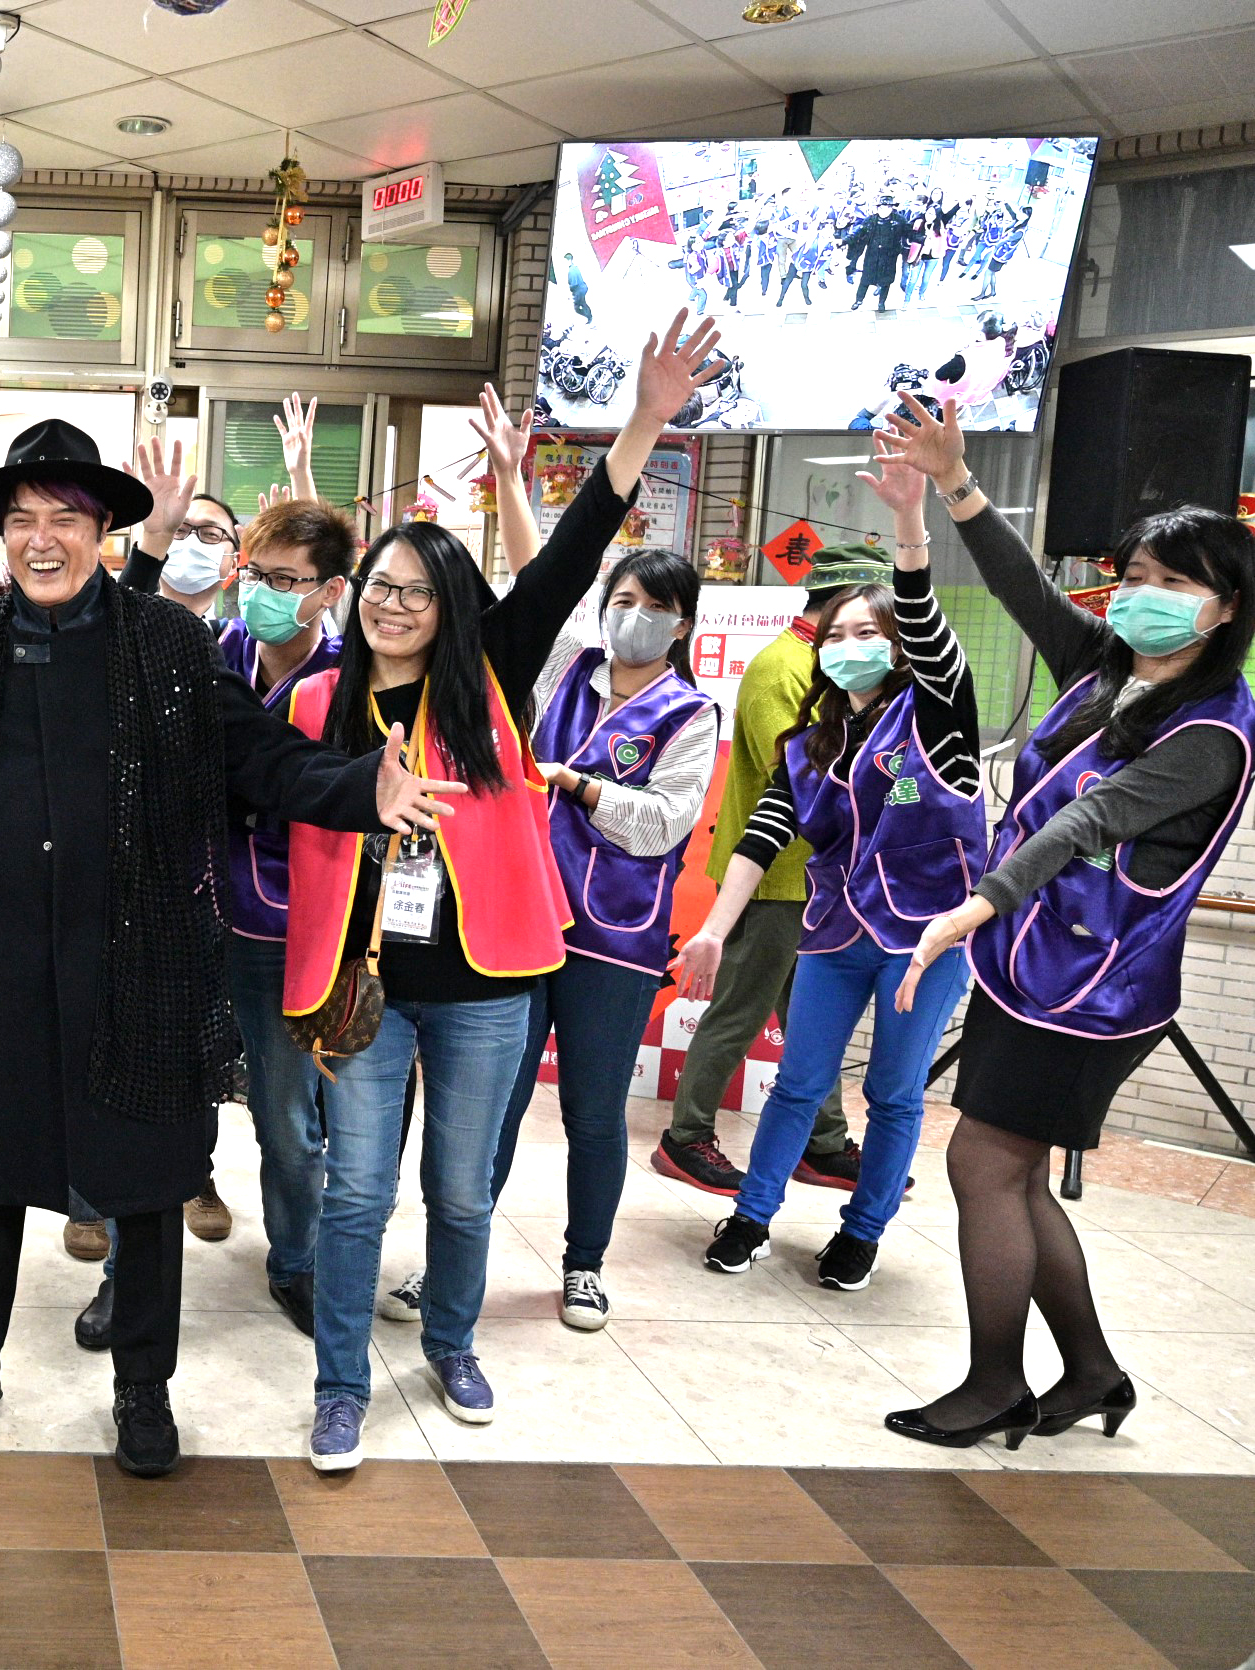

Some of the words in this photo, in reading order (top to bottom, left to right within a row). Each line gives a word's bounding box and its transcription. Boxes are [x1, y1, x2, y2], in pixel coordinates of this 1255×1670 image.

[372, 175, 424, 211] 0000
[775, 533, 812, 566] 春
[884, 776, 921, 806] 達
[393, 899, 426, 914] 徐金春
